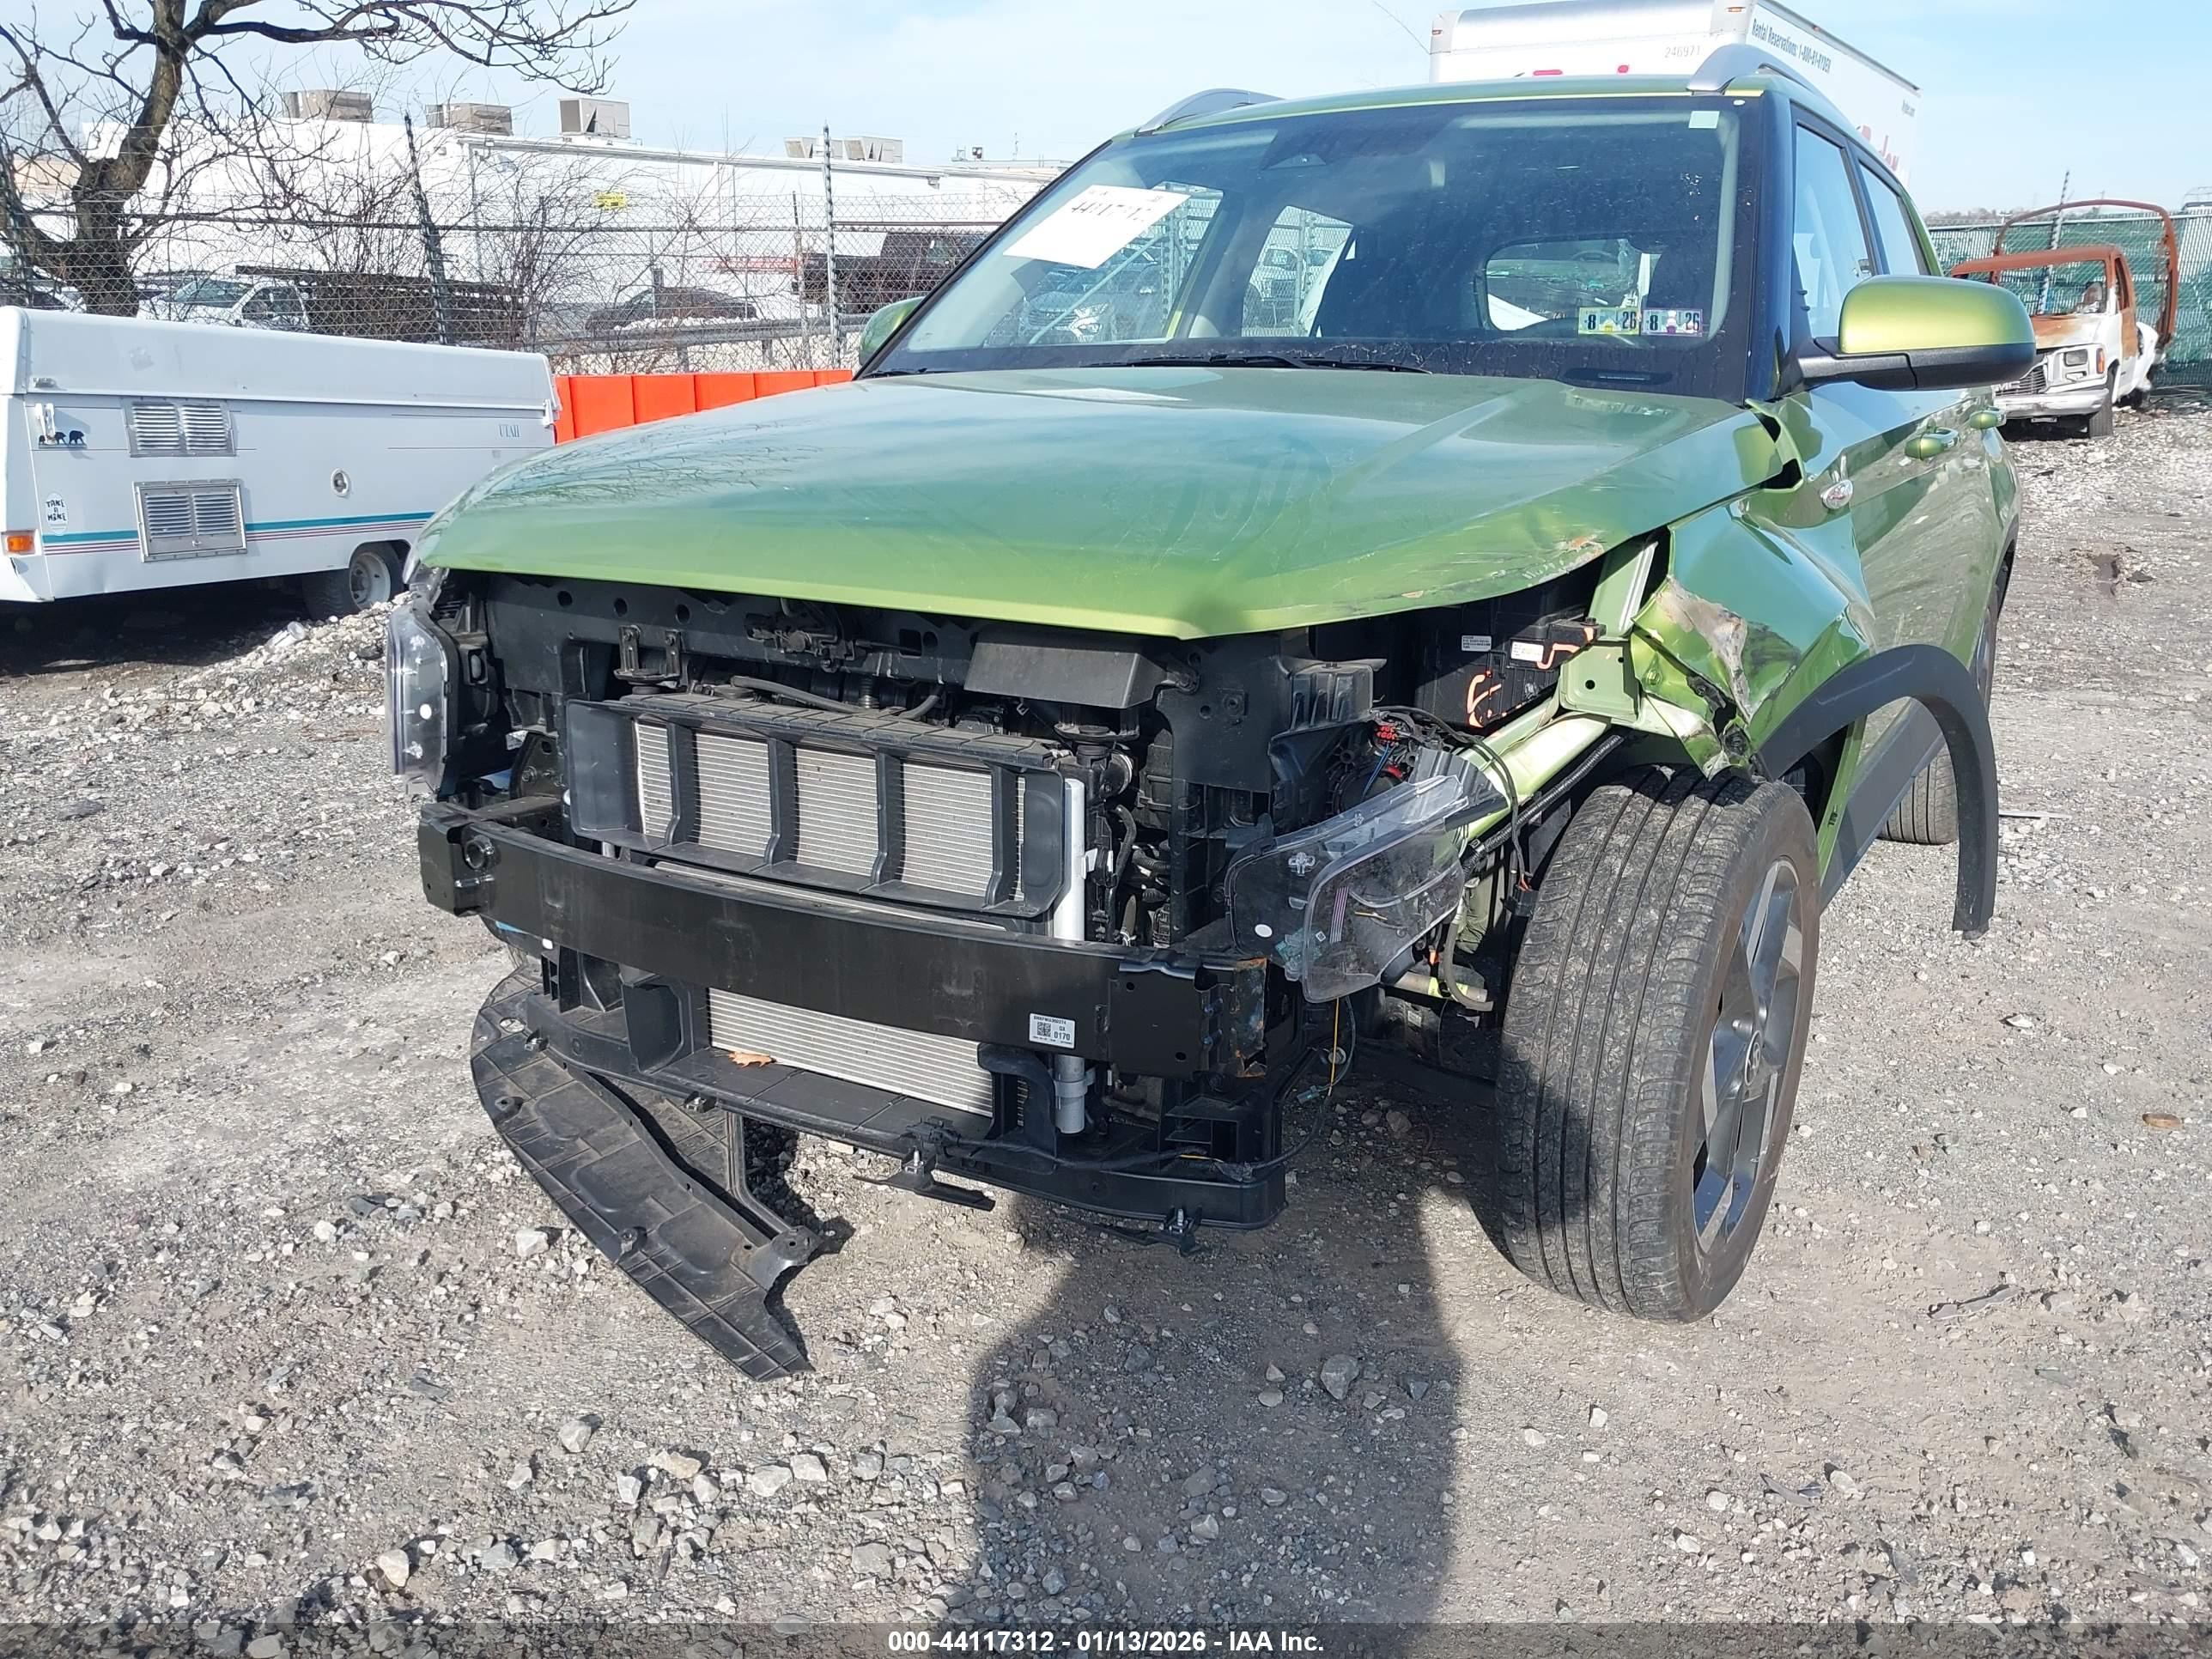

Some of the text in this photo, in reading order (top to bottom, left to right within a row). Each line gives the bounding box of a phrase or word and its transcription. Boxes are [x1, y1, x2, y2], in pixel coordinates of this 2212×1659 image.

[1751, 18, 1769, 42] Rental
[1767, 27, 1799, 57] Reservations:
[1664, 46, 1701, 58] 246971
[1587, 311, 1637, 331] 8 26
[1650, 312, 1700, 331] 8 26
[46, 499, 65, 508] TAKE
